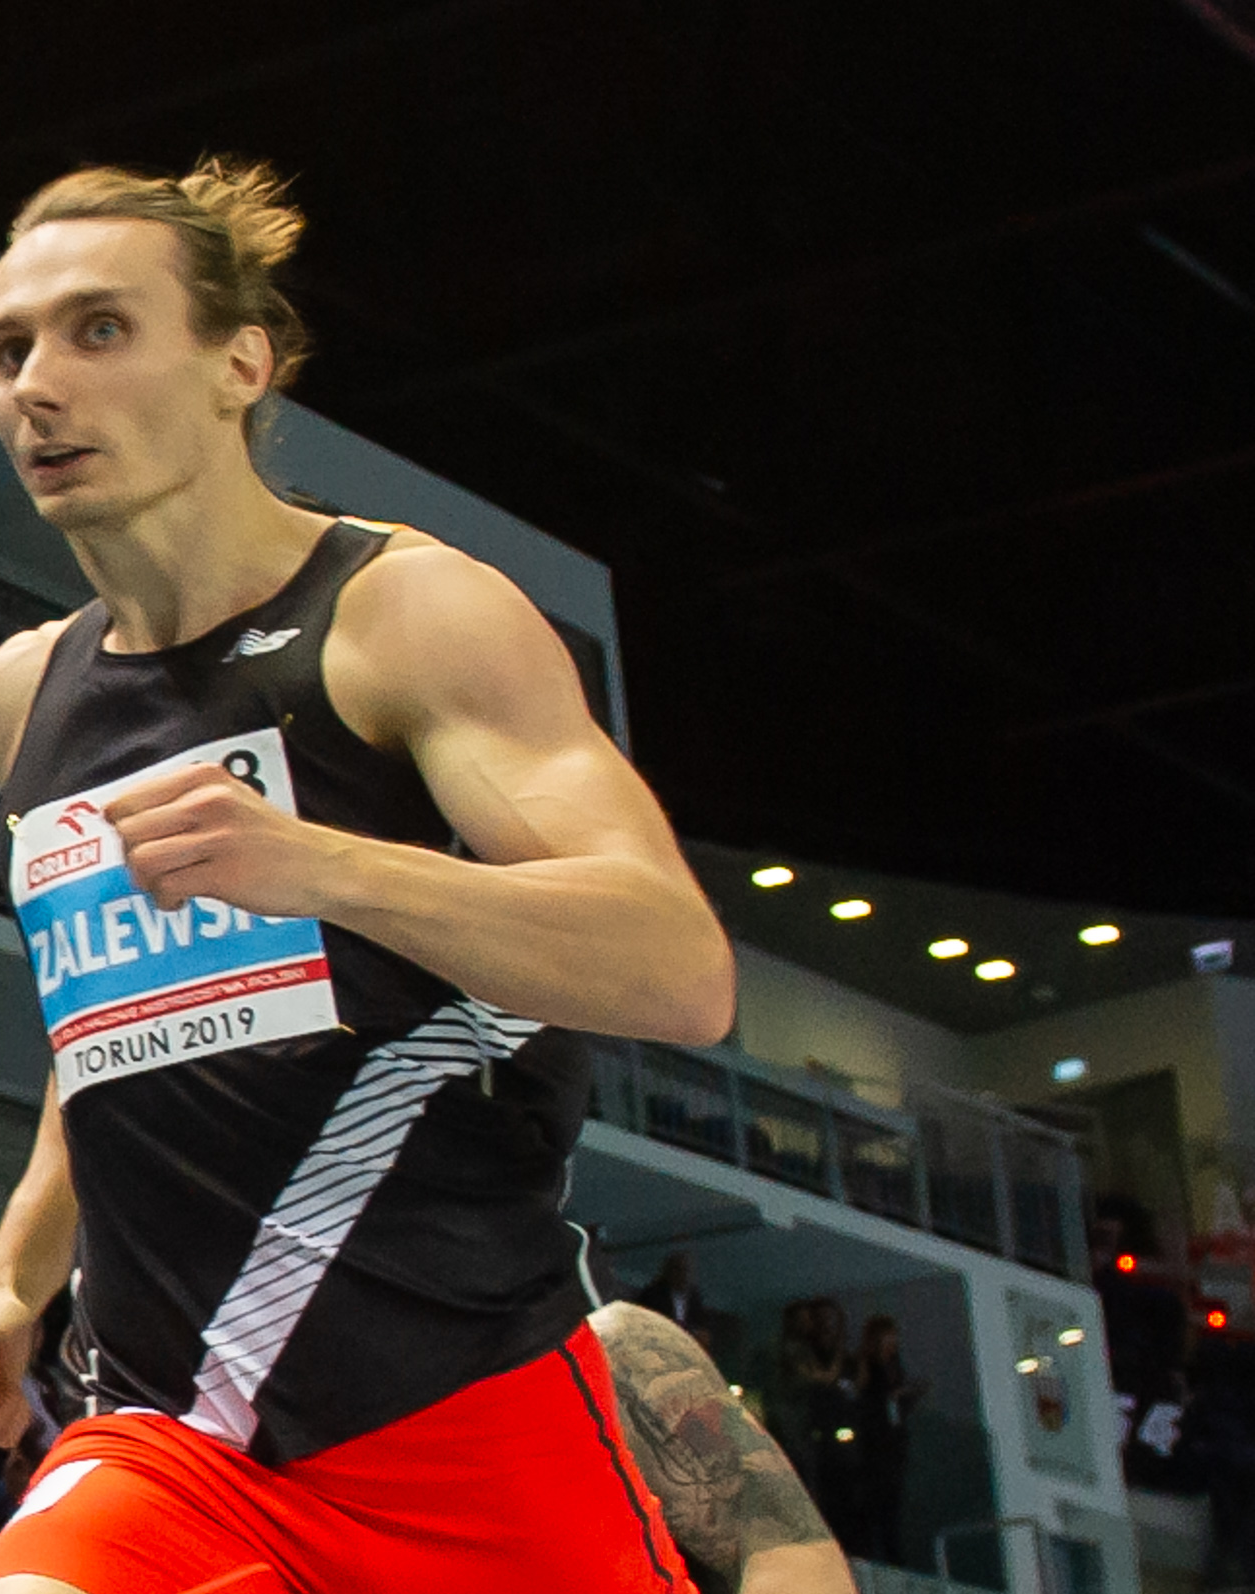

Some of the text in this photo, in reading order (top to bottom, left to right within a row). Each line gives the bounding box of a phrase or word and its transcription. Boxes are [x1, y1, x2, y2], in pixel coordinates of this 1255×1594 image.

[191, 749, 266, 798] 8
[29, 841, 99, 885] ORLEN
[28, 893, 291, 998] ZALEWS
[180, 1006, 255, 1051] 2019
